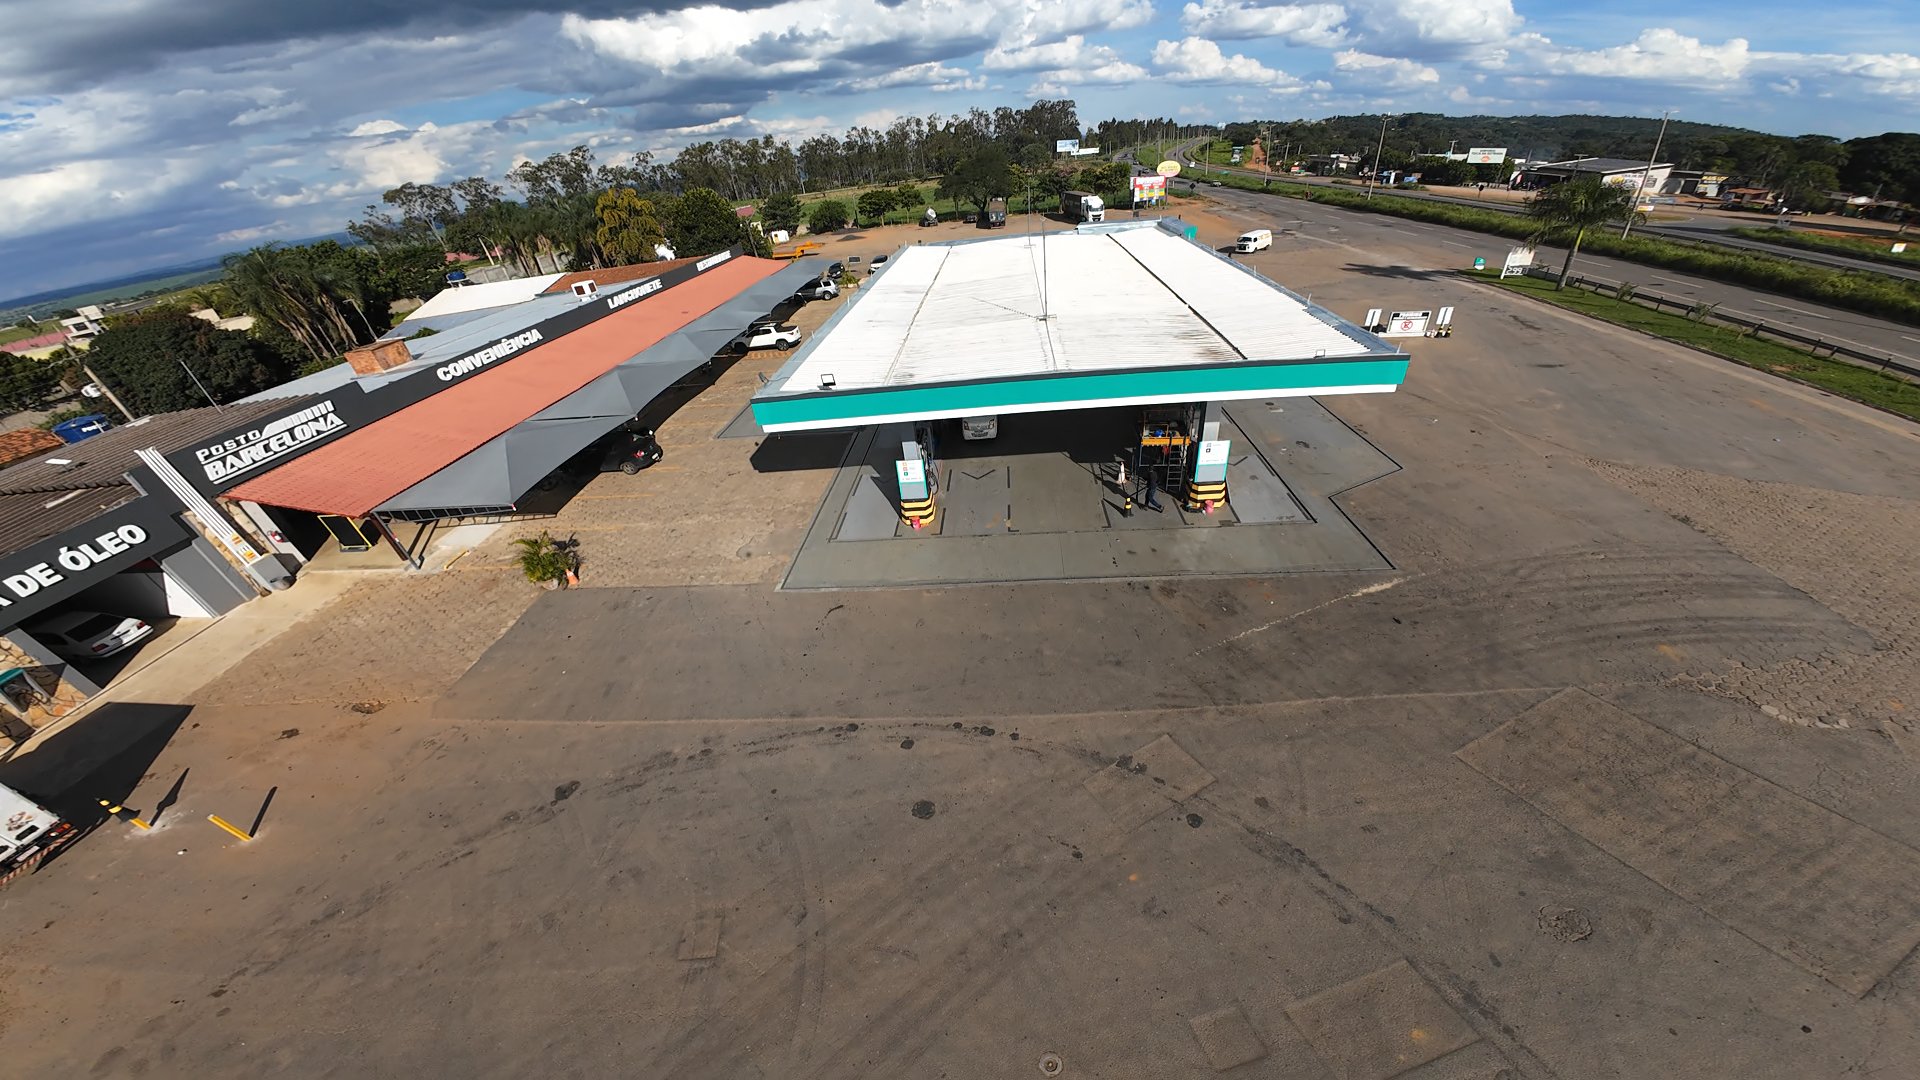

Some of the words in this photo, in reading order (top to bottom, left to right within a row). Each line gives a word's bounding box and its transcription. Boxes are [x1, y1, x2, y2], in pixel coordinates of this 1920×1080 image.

[606, 278, 663, 310] LANCHONETE
[436, 328, 544, 381] CONVENIÊNCIA
[195, 429, 262, 462] POSTO
[203, 412, 345, 482] BARCELONA
[2, 562, 64, 598] DE
[58, 524, 147, 571] ÓLEO
